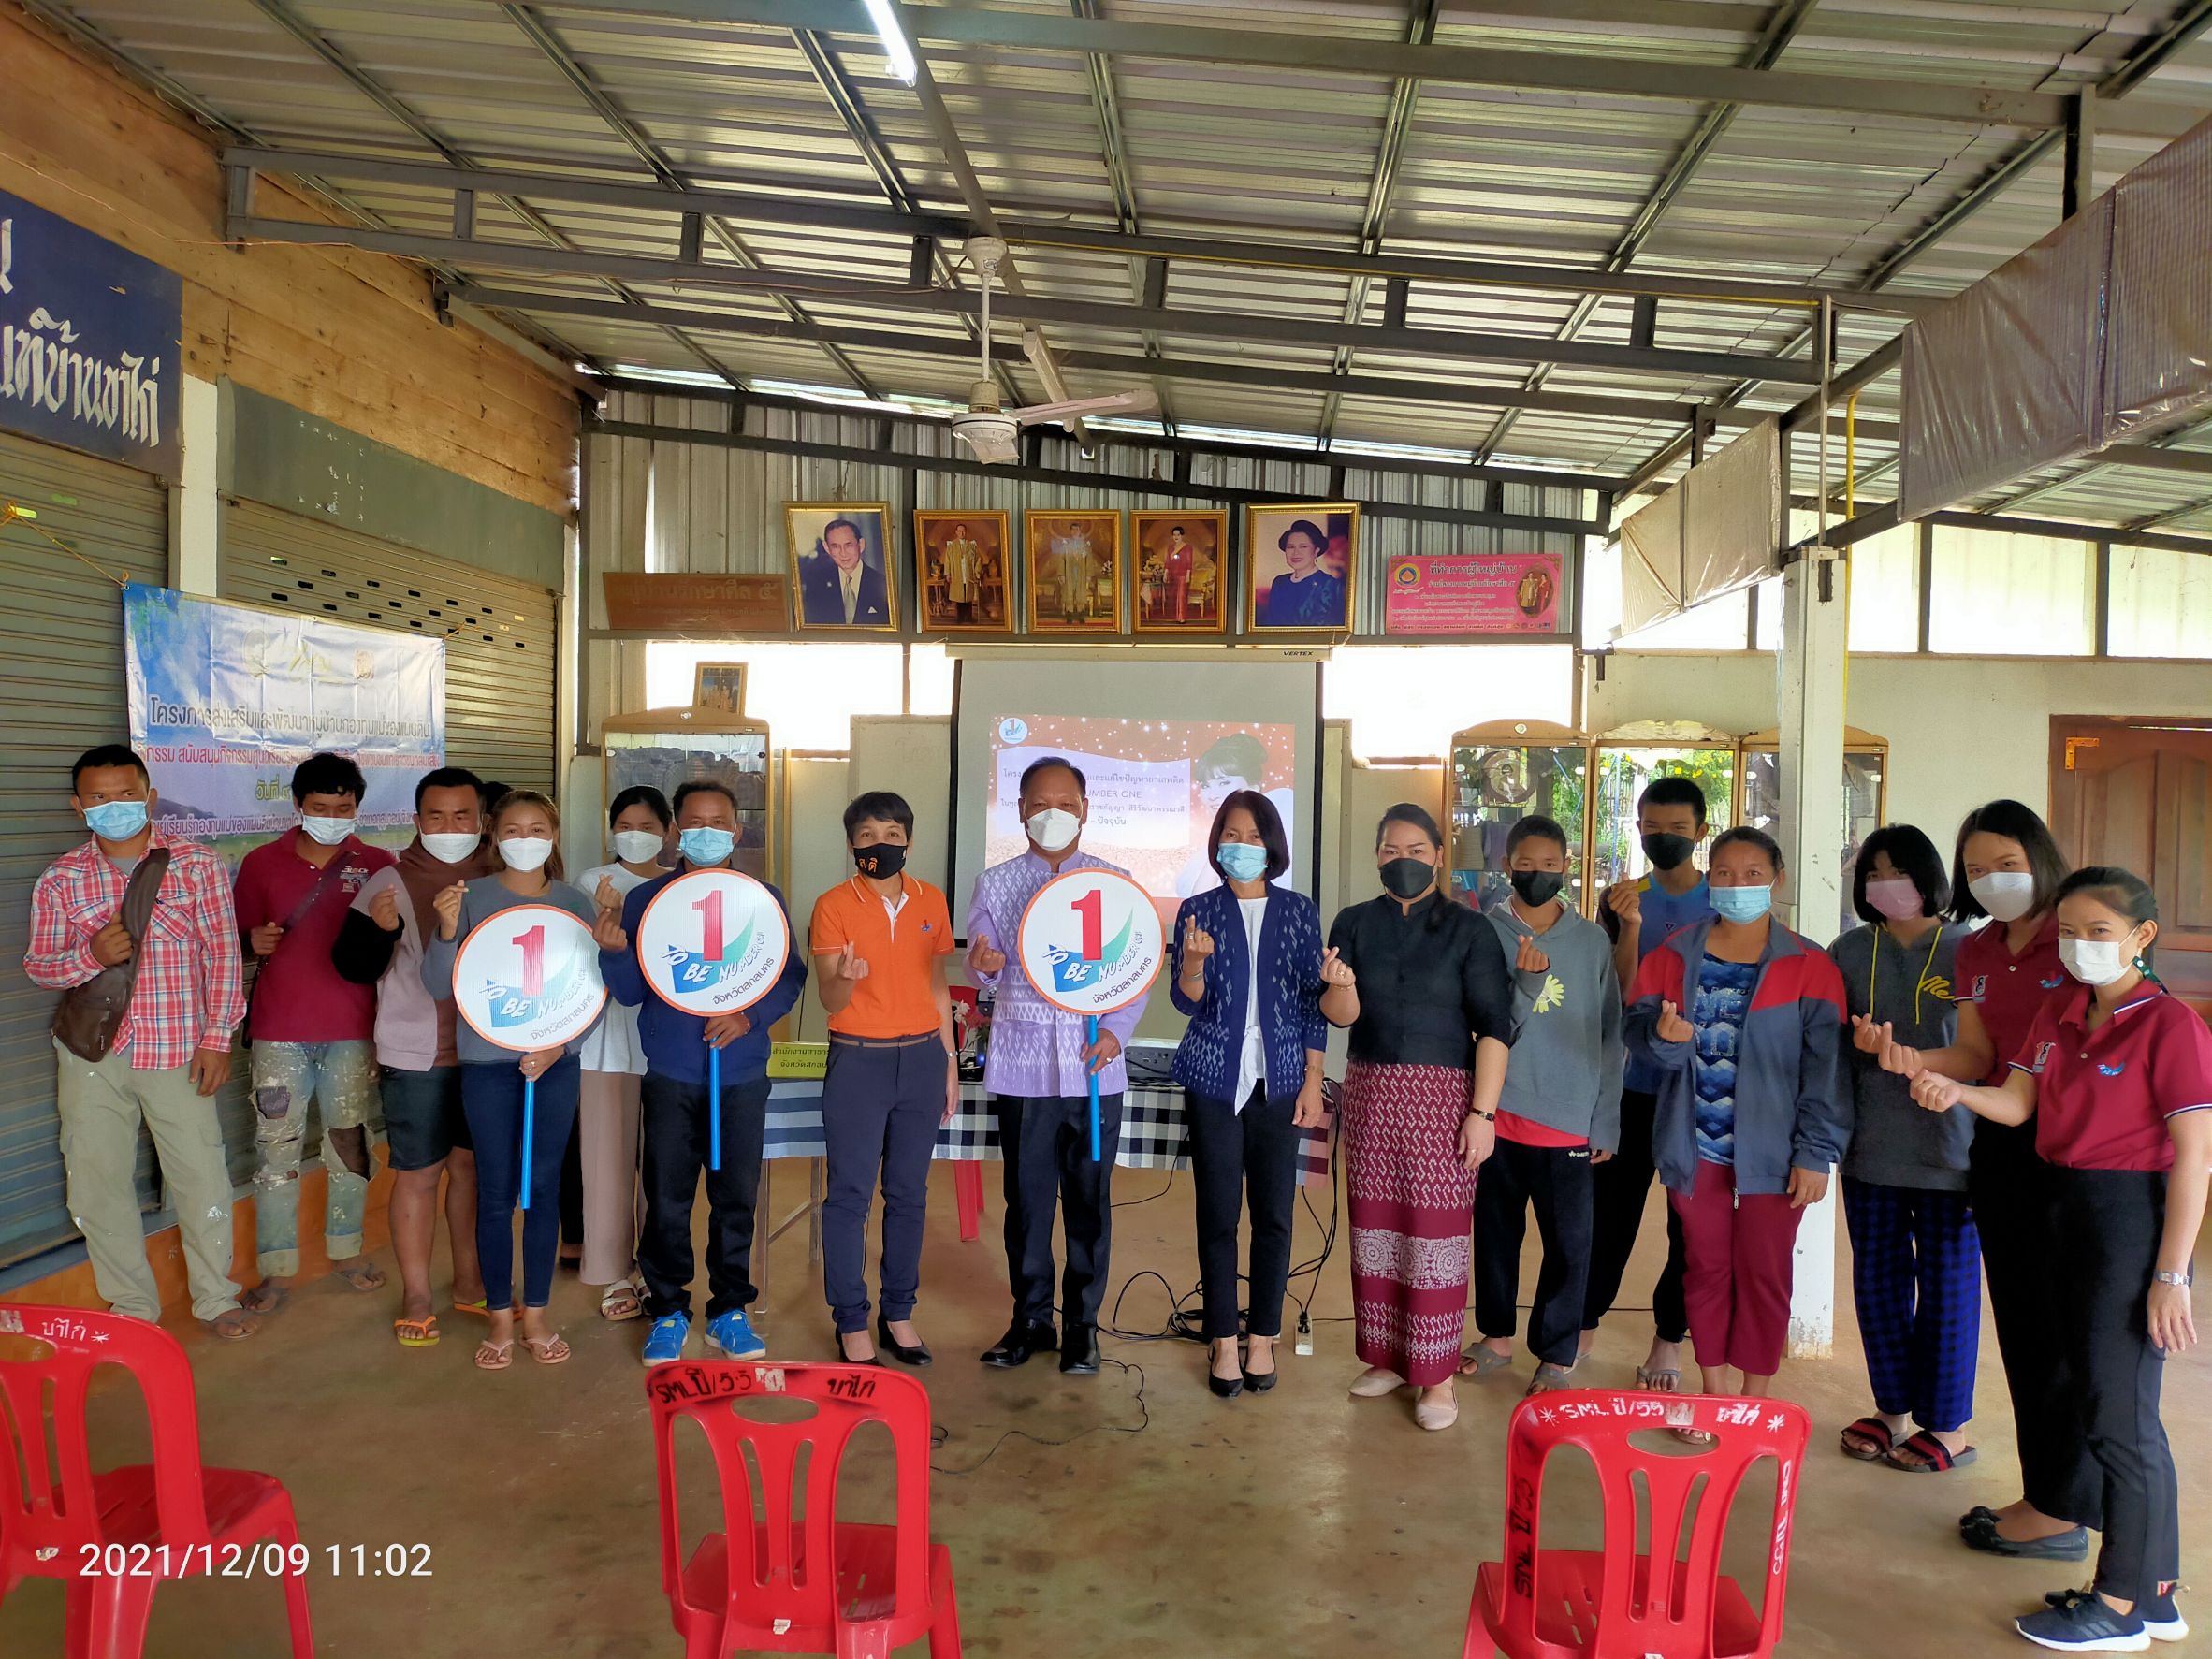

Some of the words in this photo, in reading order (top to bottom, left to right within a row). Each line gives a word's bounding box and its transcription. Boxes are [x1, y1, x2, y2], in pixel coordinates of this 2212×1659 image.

[1121, 790, 1142, 799] ONE
[692, 890, 723, 961] 1
[1071, 890, 1102, 961] 1
[512, 924, 545, 997] 1
[683, 962, 715, 983] BE
[712, 957, 775, 1005] จังหวัดสกลนคร
[1063, 962, 1093, 982] BE
[1093, 956, 1152, 1004] จังหวัดสกลนคร
[500, 997, 533, 1018] BE
[531, 993, 595, 1041] จังหวัดสกลนคร
[773, 1047, 830, 1055] สำนักงานสาธาร
